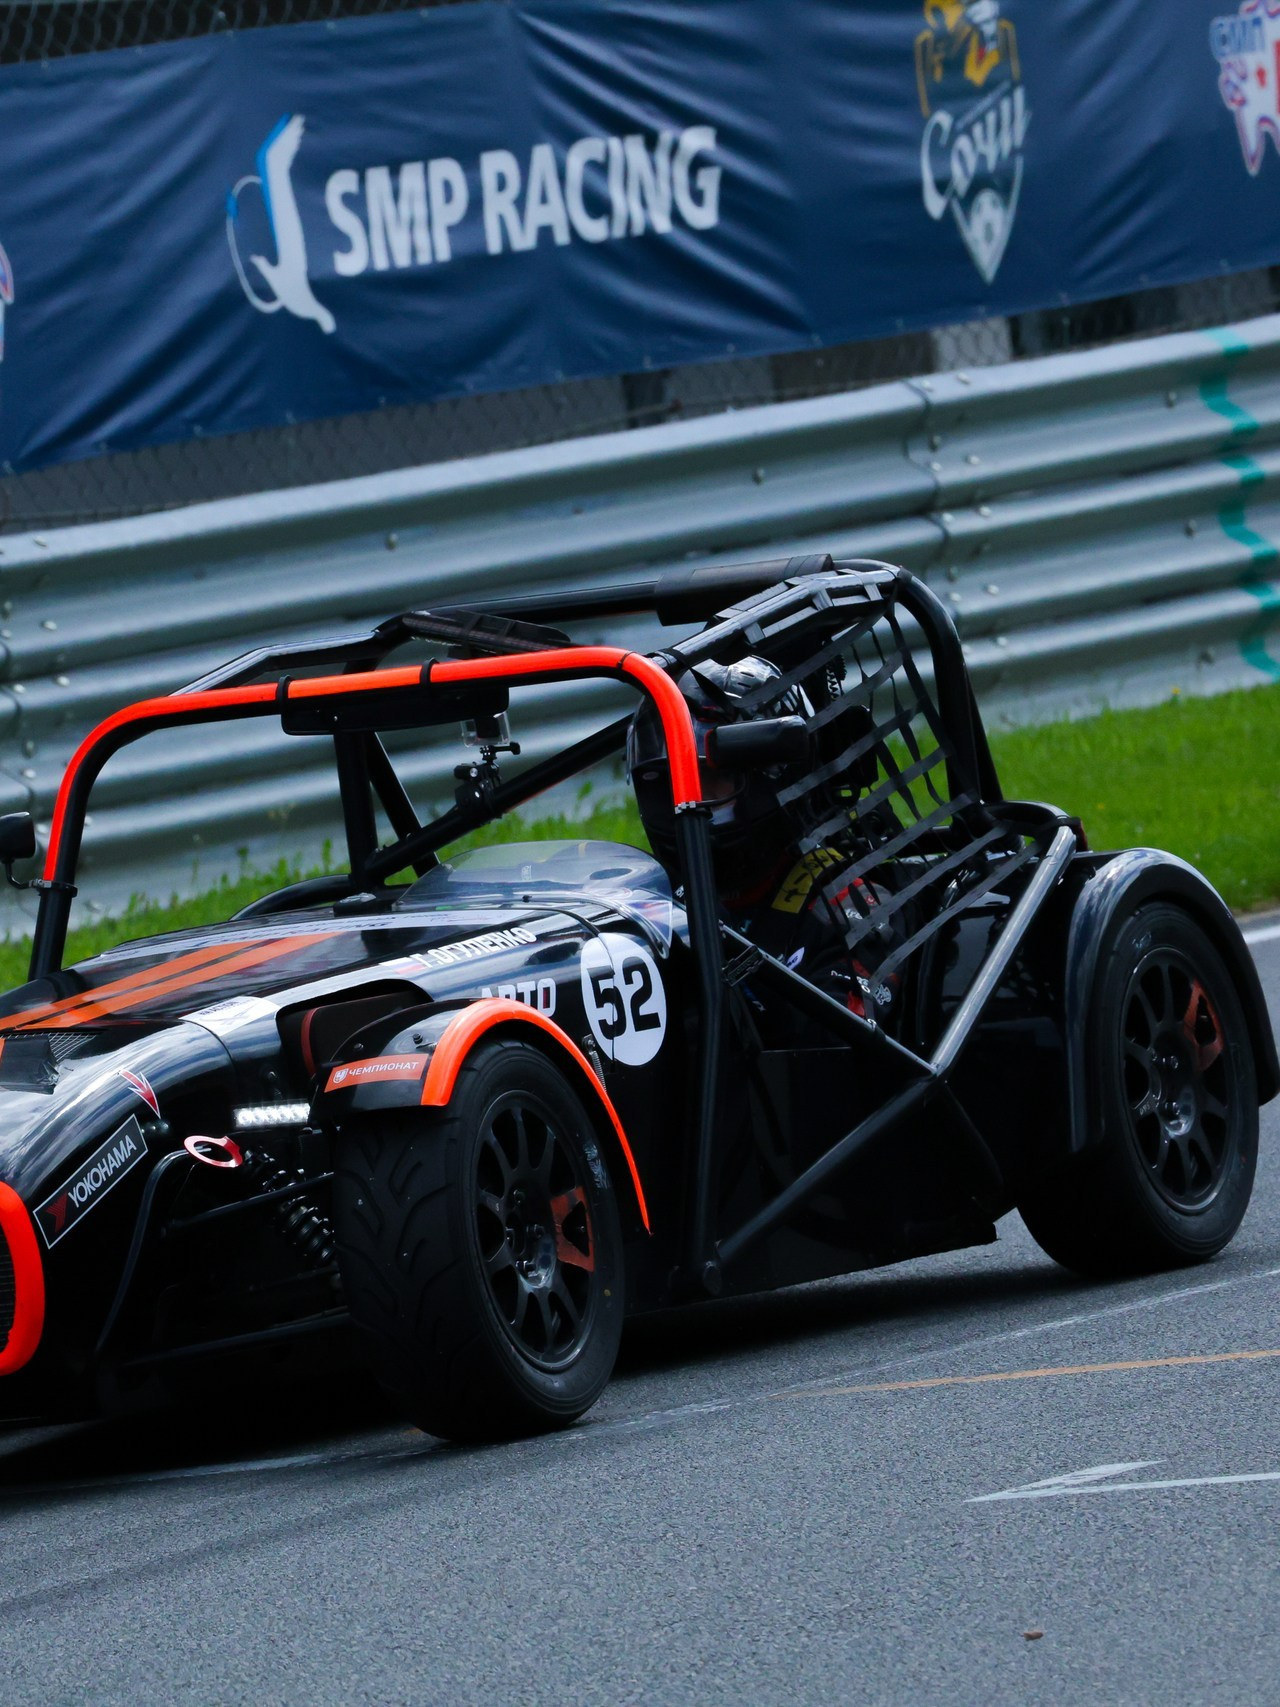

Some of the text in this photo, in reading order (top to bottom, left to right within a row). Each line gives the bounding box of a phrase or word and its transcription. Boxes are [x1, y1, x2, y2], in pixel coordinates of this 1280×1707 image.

[325, 125, 721, 277] SMP RACING
[586, 956, 662, 1041] 52
[348, 1061, 419, 1076] ЧЕМПИОНАТ
[67, 1134, 137, 1208] YOKOHAMA
